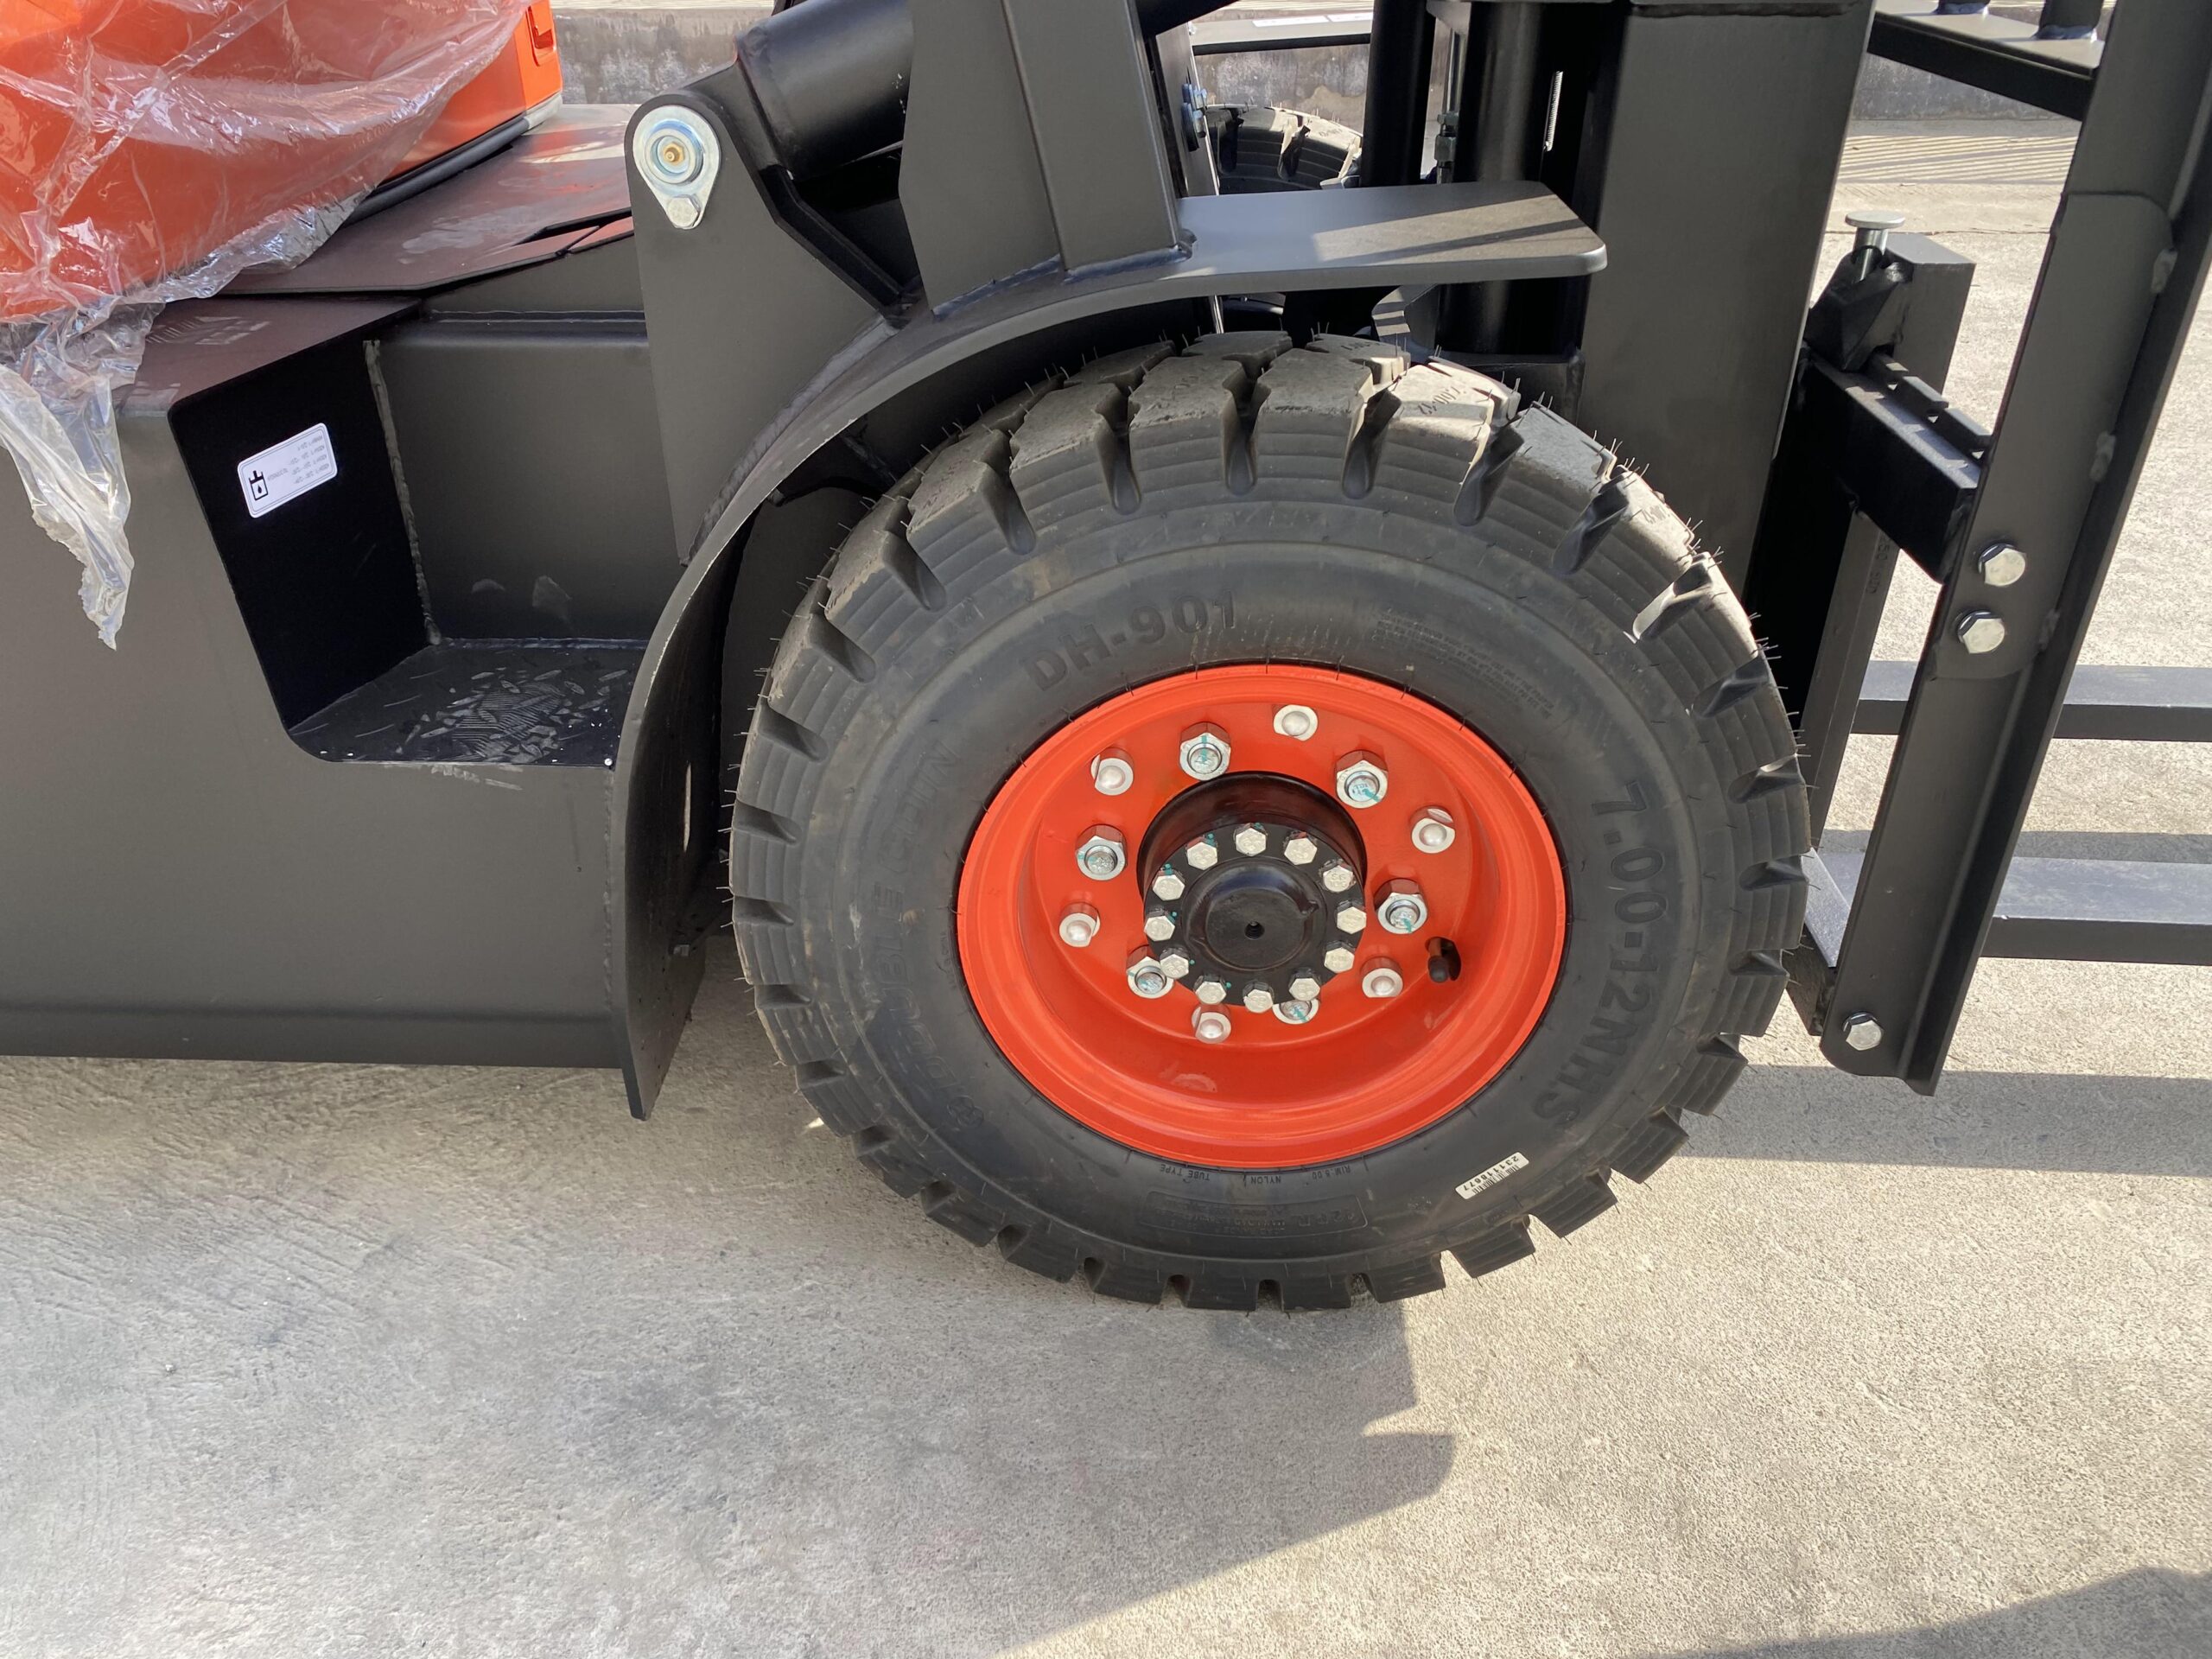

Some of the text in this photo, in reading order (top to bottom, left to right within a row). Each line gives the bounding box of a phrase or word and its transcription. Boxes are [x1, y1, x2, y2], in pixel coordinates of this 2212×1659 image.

[1020, 588, 1236, 691] DH-901
[1533, 781, 1669, 1123] 7.00-12NHS
[1160, 1163, 1210, 1181] TUBE TYPE
[1250, 1175, 1281, 1185] NYLON
